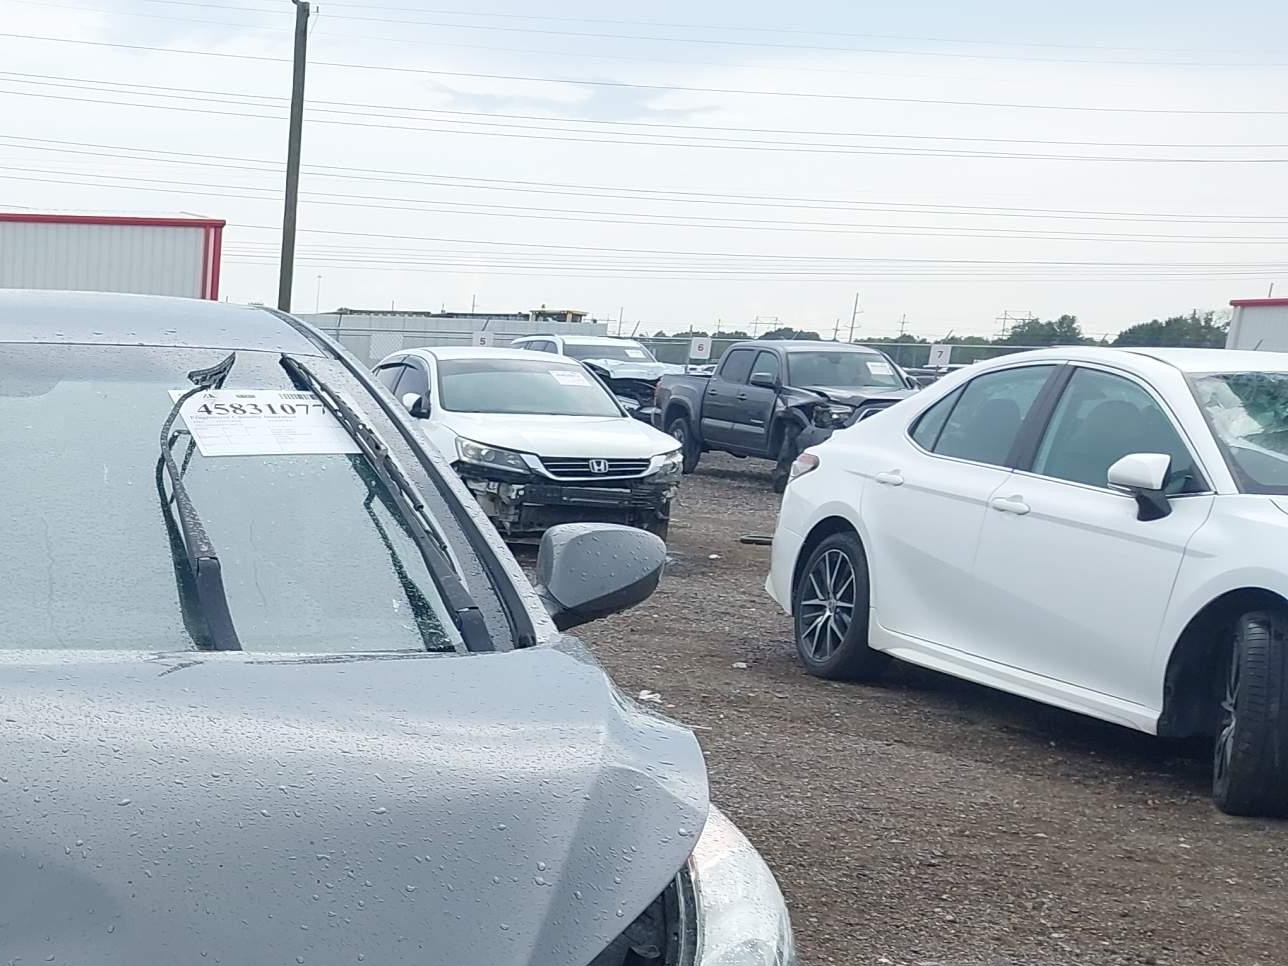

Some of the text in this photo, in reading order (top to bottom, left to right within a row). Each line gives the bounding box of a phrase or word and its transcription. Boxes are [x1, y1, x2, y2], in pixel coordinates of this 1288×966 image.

[479, 337, 486, 345] 5
[697, 343, 704, 352] 6
[937, 350, 944, 359] 7
[197, 402, 325, 415] 45831077
